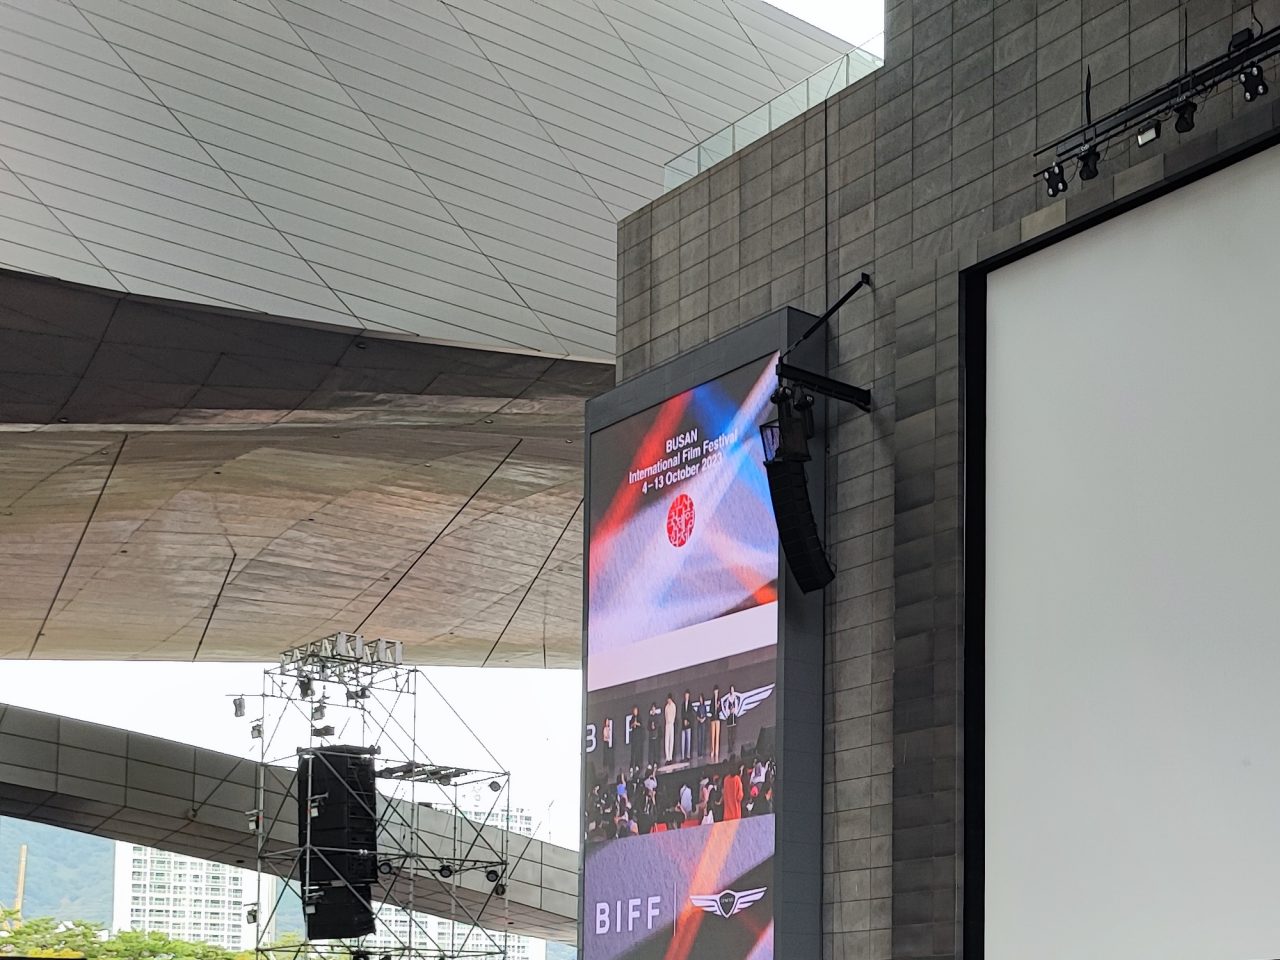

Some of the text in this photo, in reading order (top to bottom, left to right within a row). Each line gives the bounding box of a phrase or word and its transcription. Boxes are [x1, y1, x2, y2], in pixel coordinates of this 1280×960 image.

[629, 429, 738, 484] International Film Festival
[666, 428, 698, 453] BUSAN
[665, 463, 700, 485] October
[702, 453, 722, 471] 2023
[595, 895, 661, 935] BIFF
